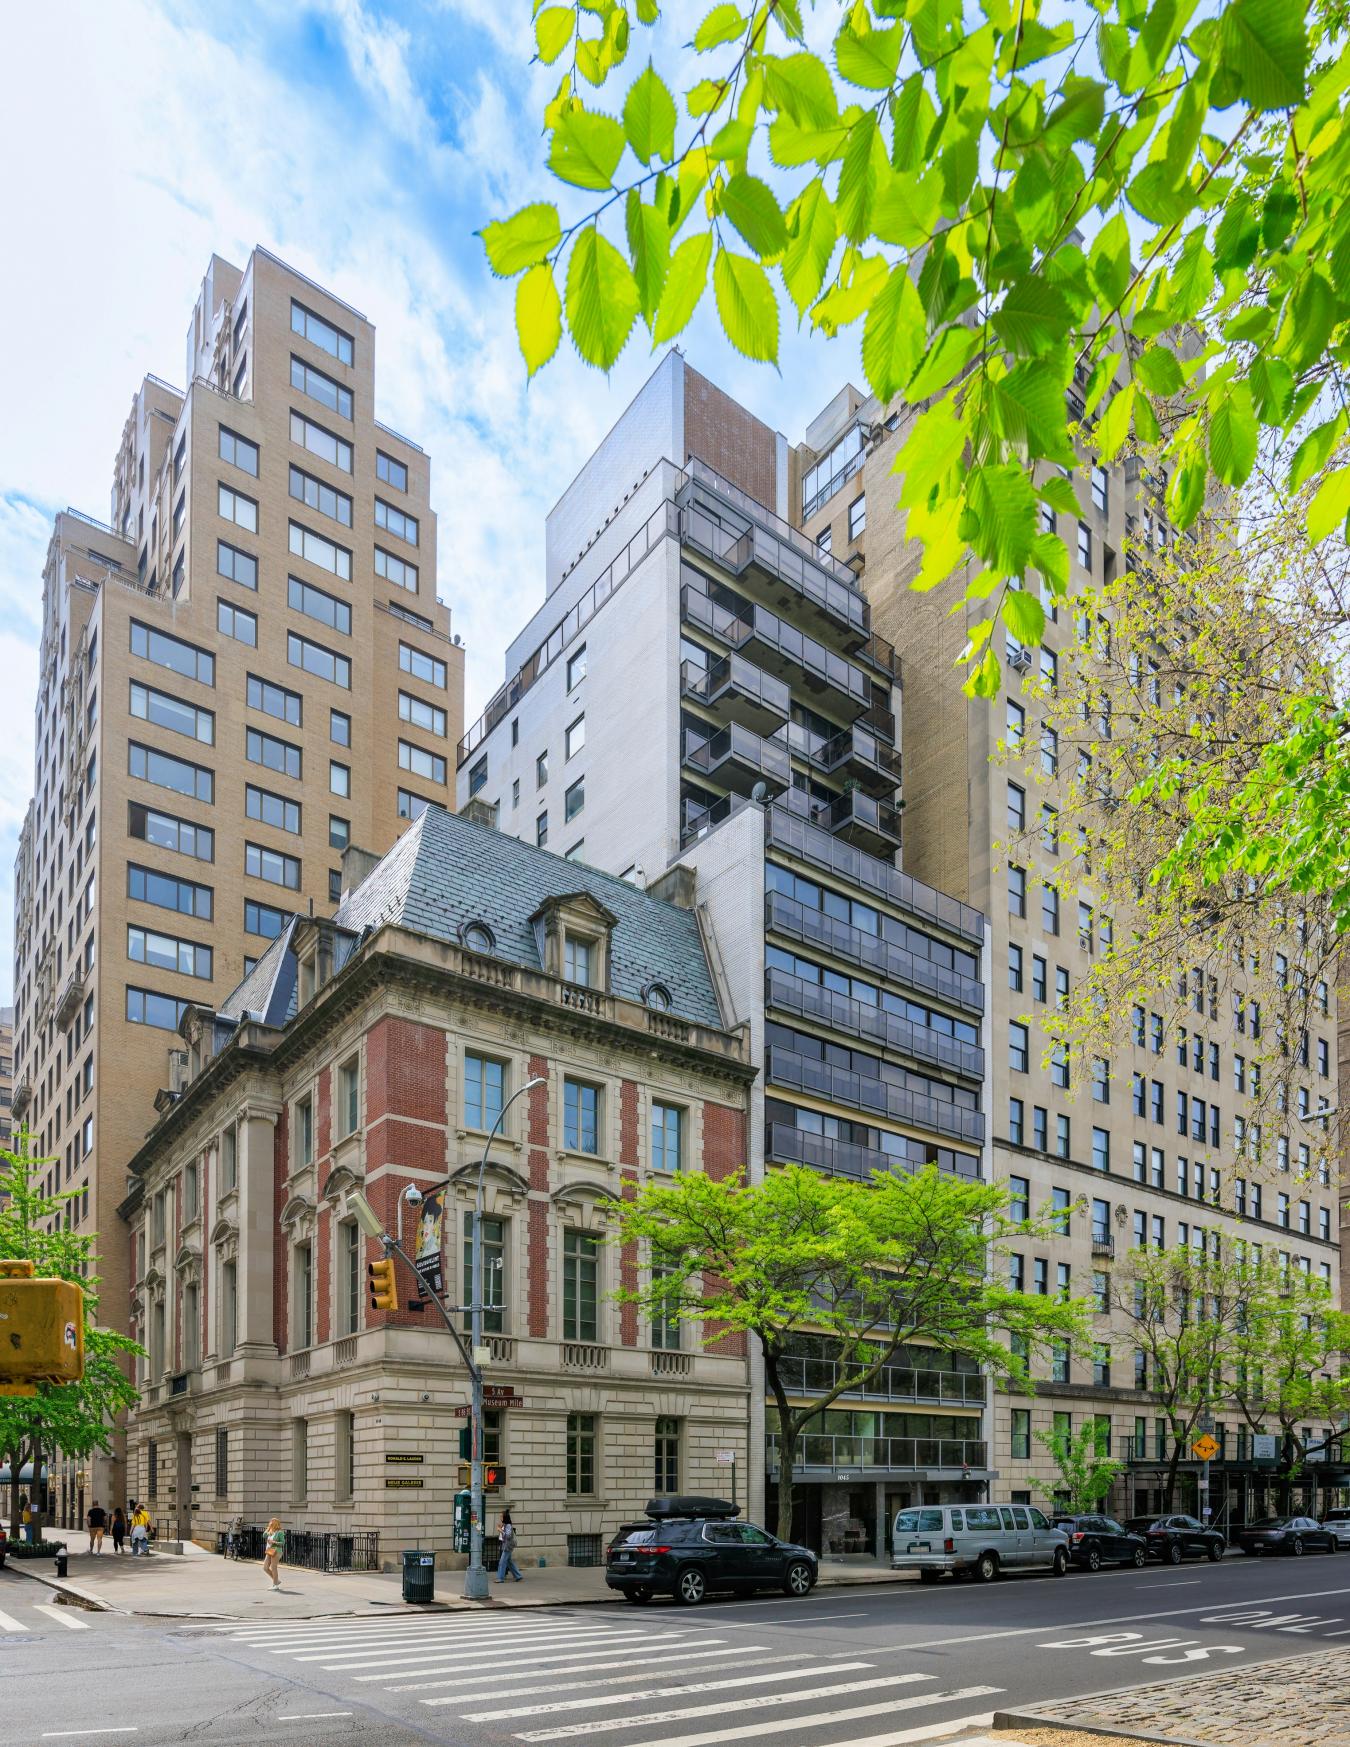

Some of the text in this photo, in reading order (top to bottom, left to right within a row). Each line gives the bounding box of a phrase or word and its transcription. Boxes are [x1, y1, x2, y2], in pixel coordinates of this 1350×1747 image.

[491, 1387, 495, 1396] 5
[484, 1398, 523, 1407] Museum Mile
[1035, 1632, 1246, 1665] BUS
